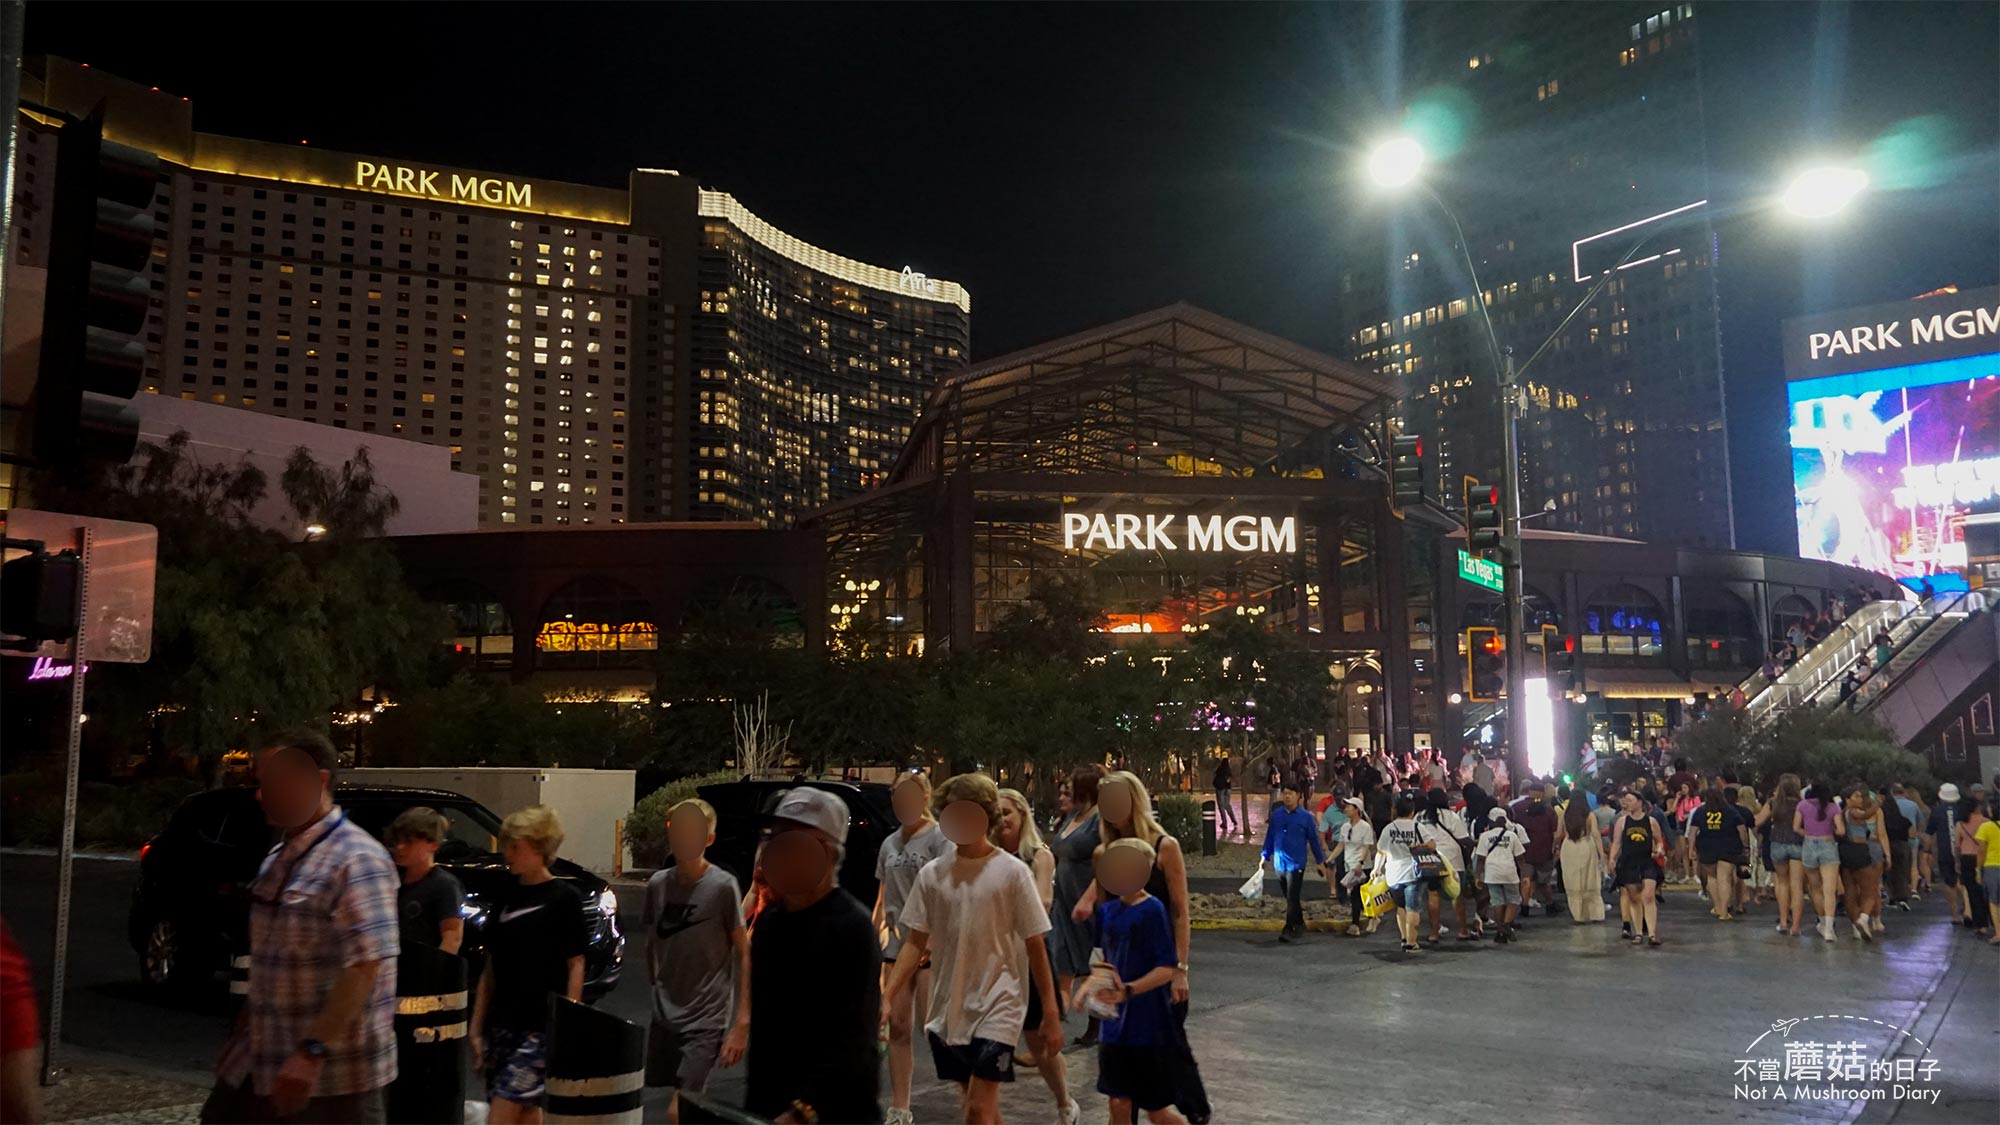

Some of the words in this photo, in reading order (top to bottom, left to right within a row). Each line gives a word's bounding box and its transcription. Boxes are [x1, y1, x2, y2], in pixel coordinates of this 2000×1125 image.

[356, 161, 440, 196] PARK
[451, 174, 532, 207] MGM
[1809, 321, 1902, 360] PARK
[1064, 513, 1178, 550] PARK
[1187, 515, 1297, 553] MGM
[1463, 551, 1475, 575] Las
[1475, 558, 1494, 586] Vegas
[1706, 811, 1722, 825] 22
